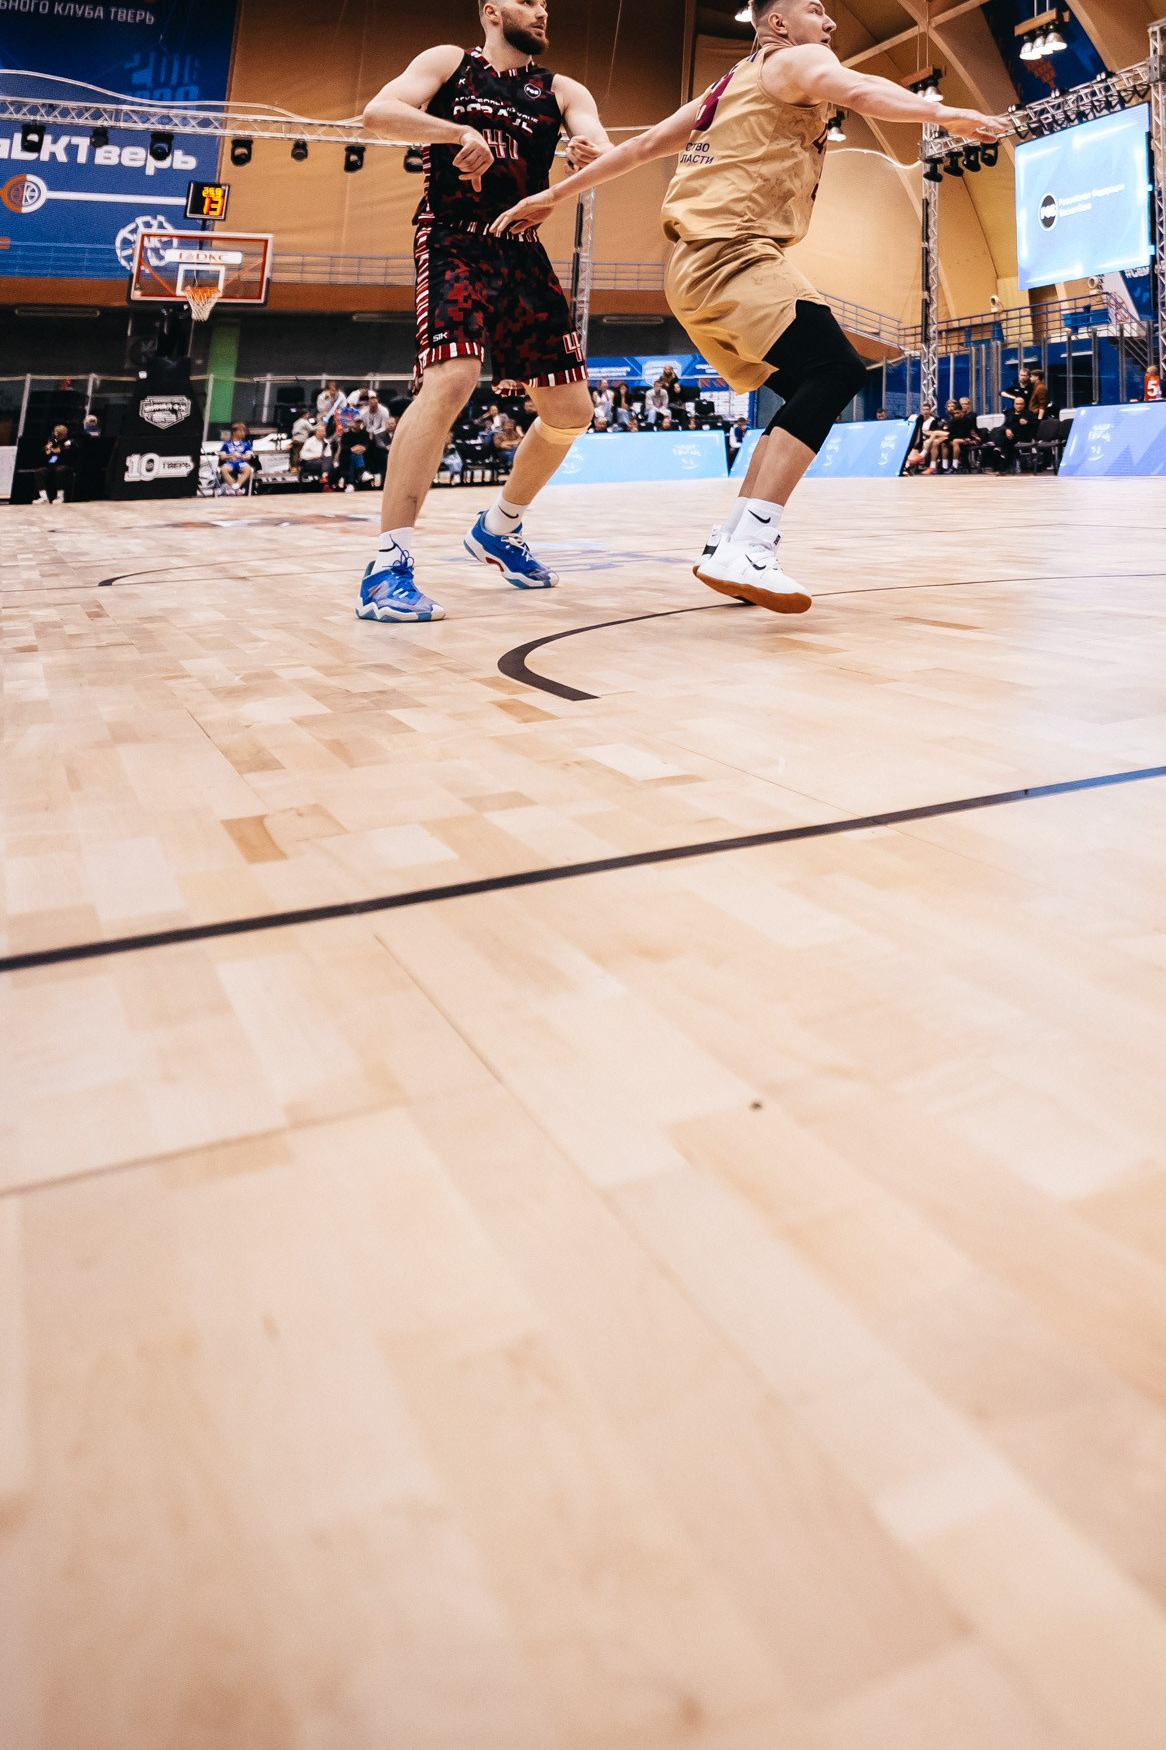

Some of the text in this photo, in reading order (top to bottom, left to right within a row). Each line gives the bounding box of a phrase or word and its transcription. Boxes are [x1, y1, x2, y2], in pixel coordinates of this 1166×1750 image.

[54, 1, 104, 20] КЛУБА
[109, 5, 155, 26] ТВЕРЬ
[1146, 380, 1158, 397] 5
